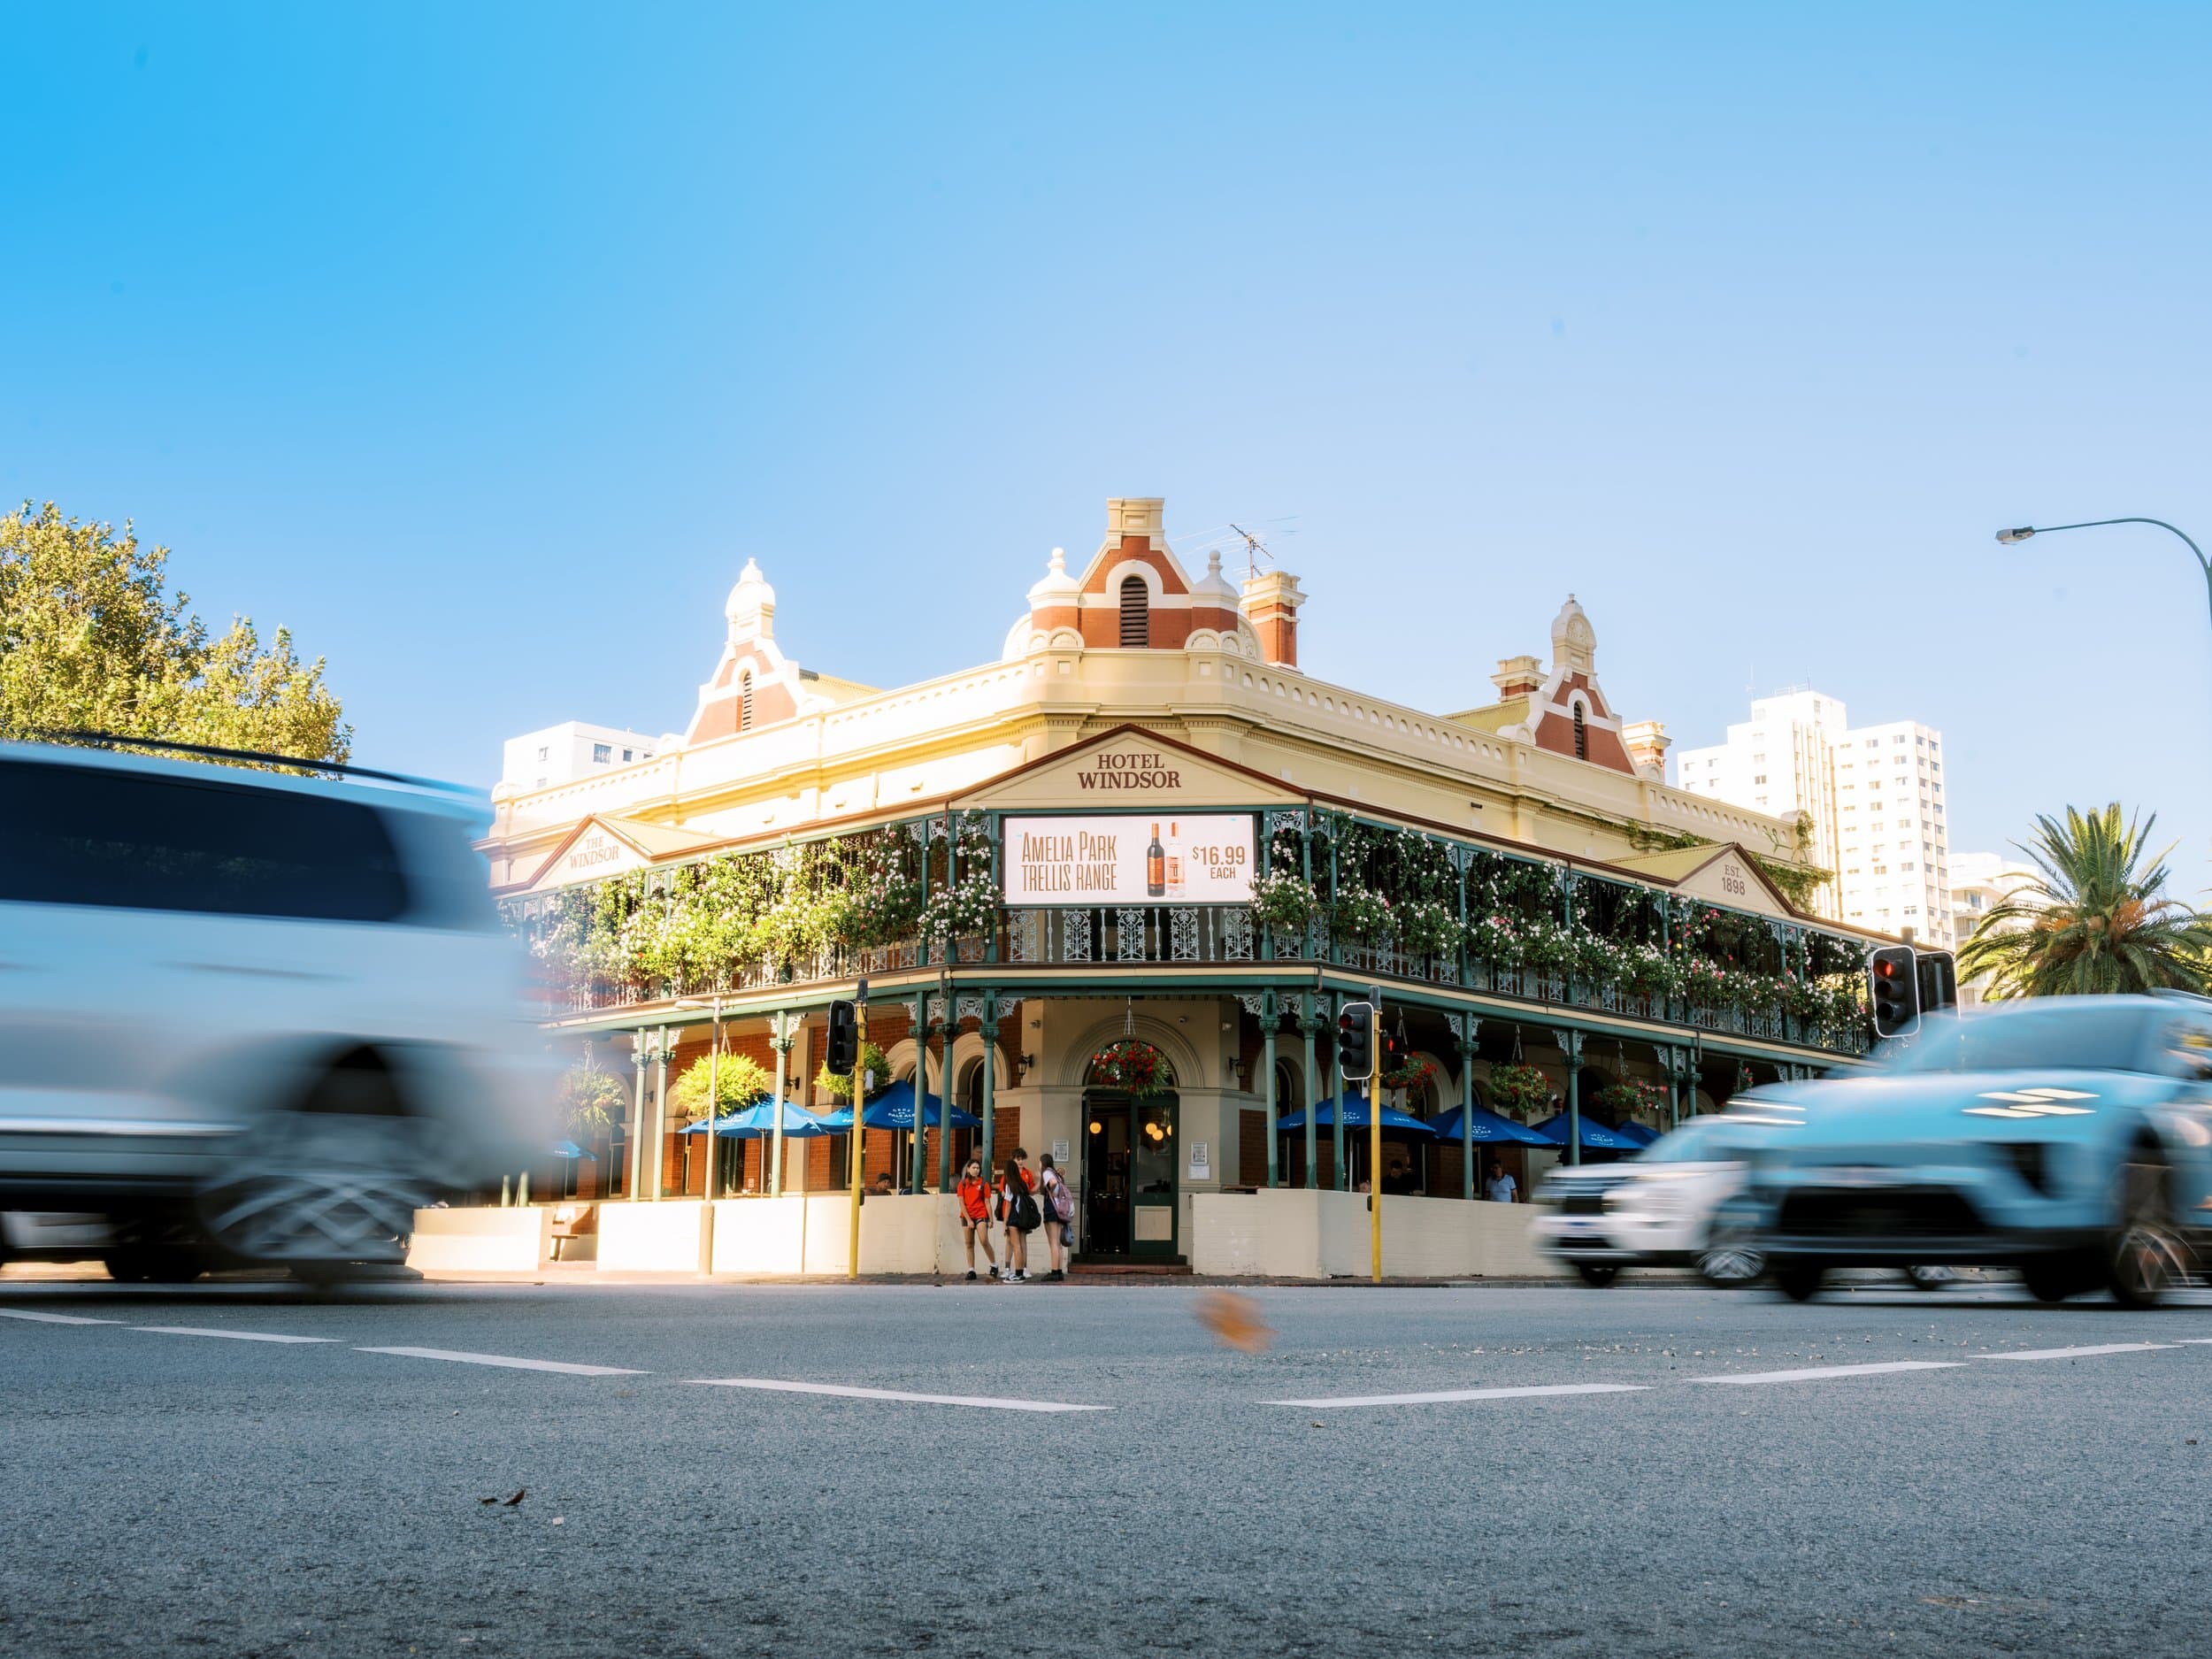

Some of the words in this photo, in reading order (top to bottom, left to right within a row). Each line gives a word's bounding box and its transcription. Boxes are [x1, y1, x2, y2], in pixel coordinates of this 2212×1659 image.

[1097, 754, 1165, 770] HOTEL
[1078, 771, 1181, 789] WINDSOR
[586, 836, 604, 850] THE
[570, 845, 619, 870] WINDSOR
[1192, 846, 1246, 865] $16.99
[1022, 864, 1071, 892] TRELLIS
[1076, 863, 1118, 891] RANGE
[1210, 867, 1236, 879] EACH
[1724, 864, 1741, 878] EST.
[1722, 877, 1746, 895] 1898
